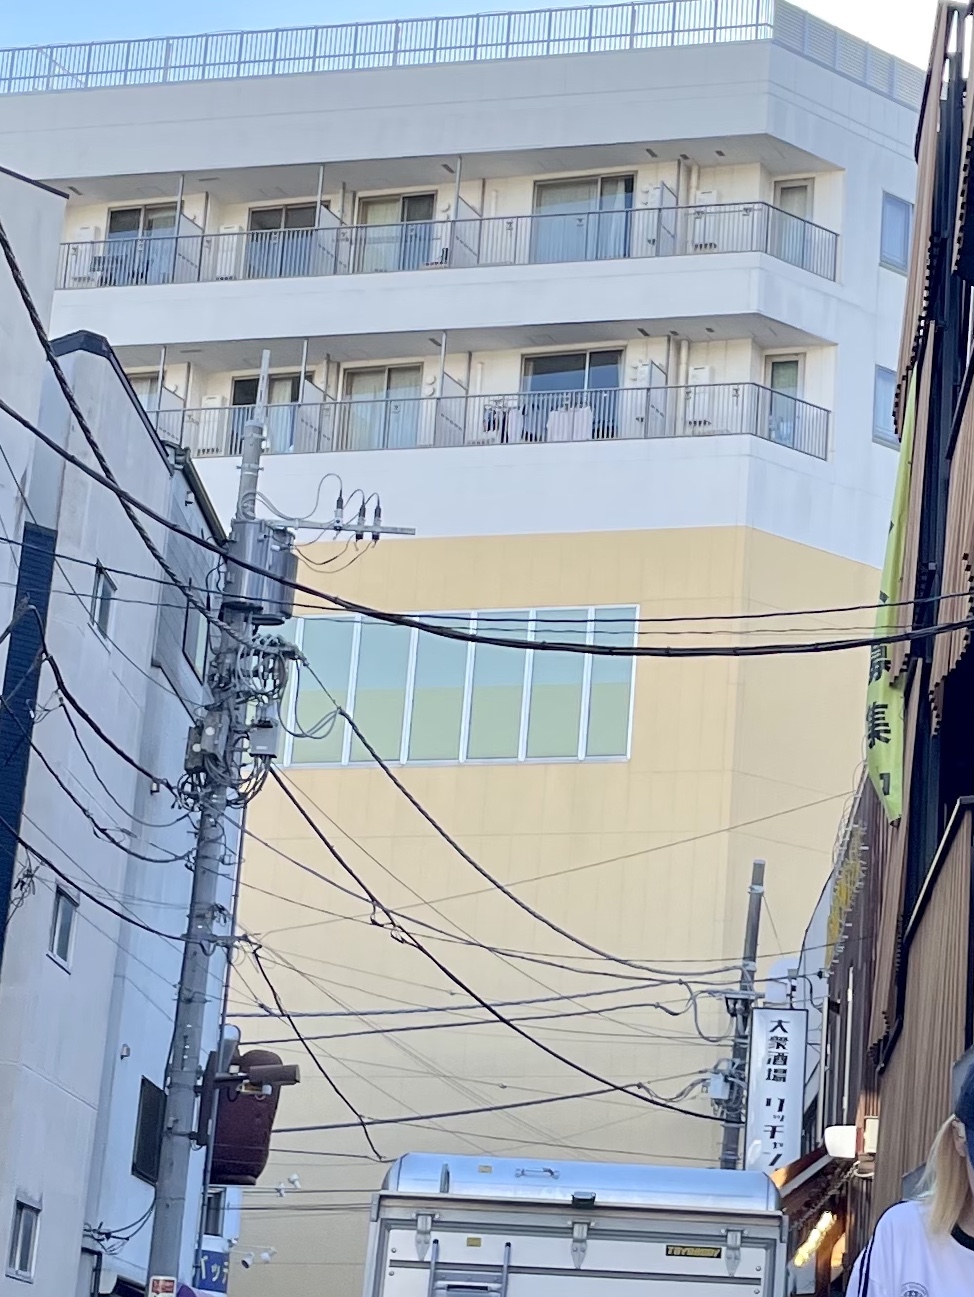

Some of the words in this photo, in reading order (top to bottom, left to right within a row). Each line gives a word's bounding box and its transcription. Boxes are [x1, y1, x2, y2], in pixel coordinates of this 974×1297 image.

[765, 1019, 791, 1083] 大衆酒場
[762, 1097, 786, 1171] リッチャン
